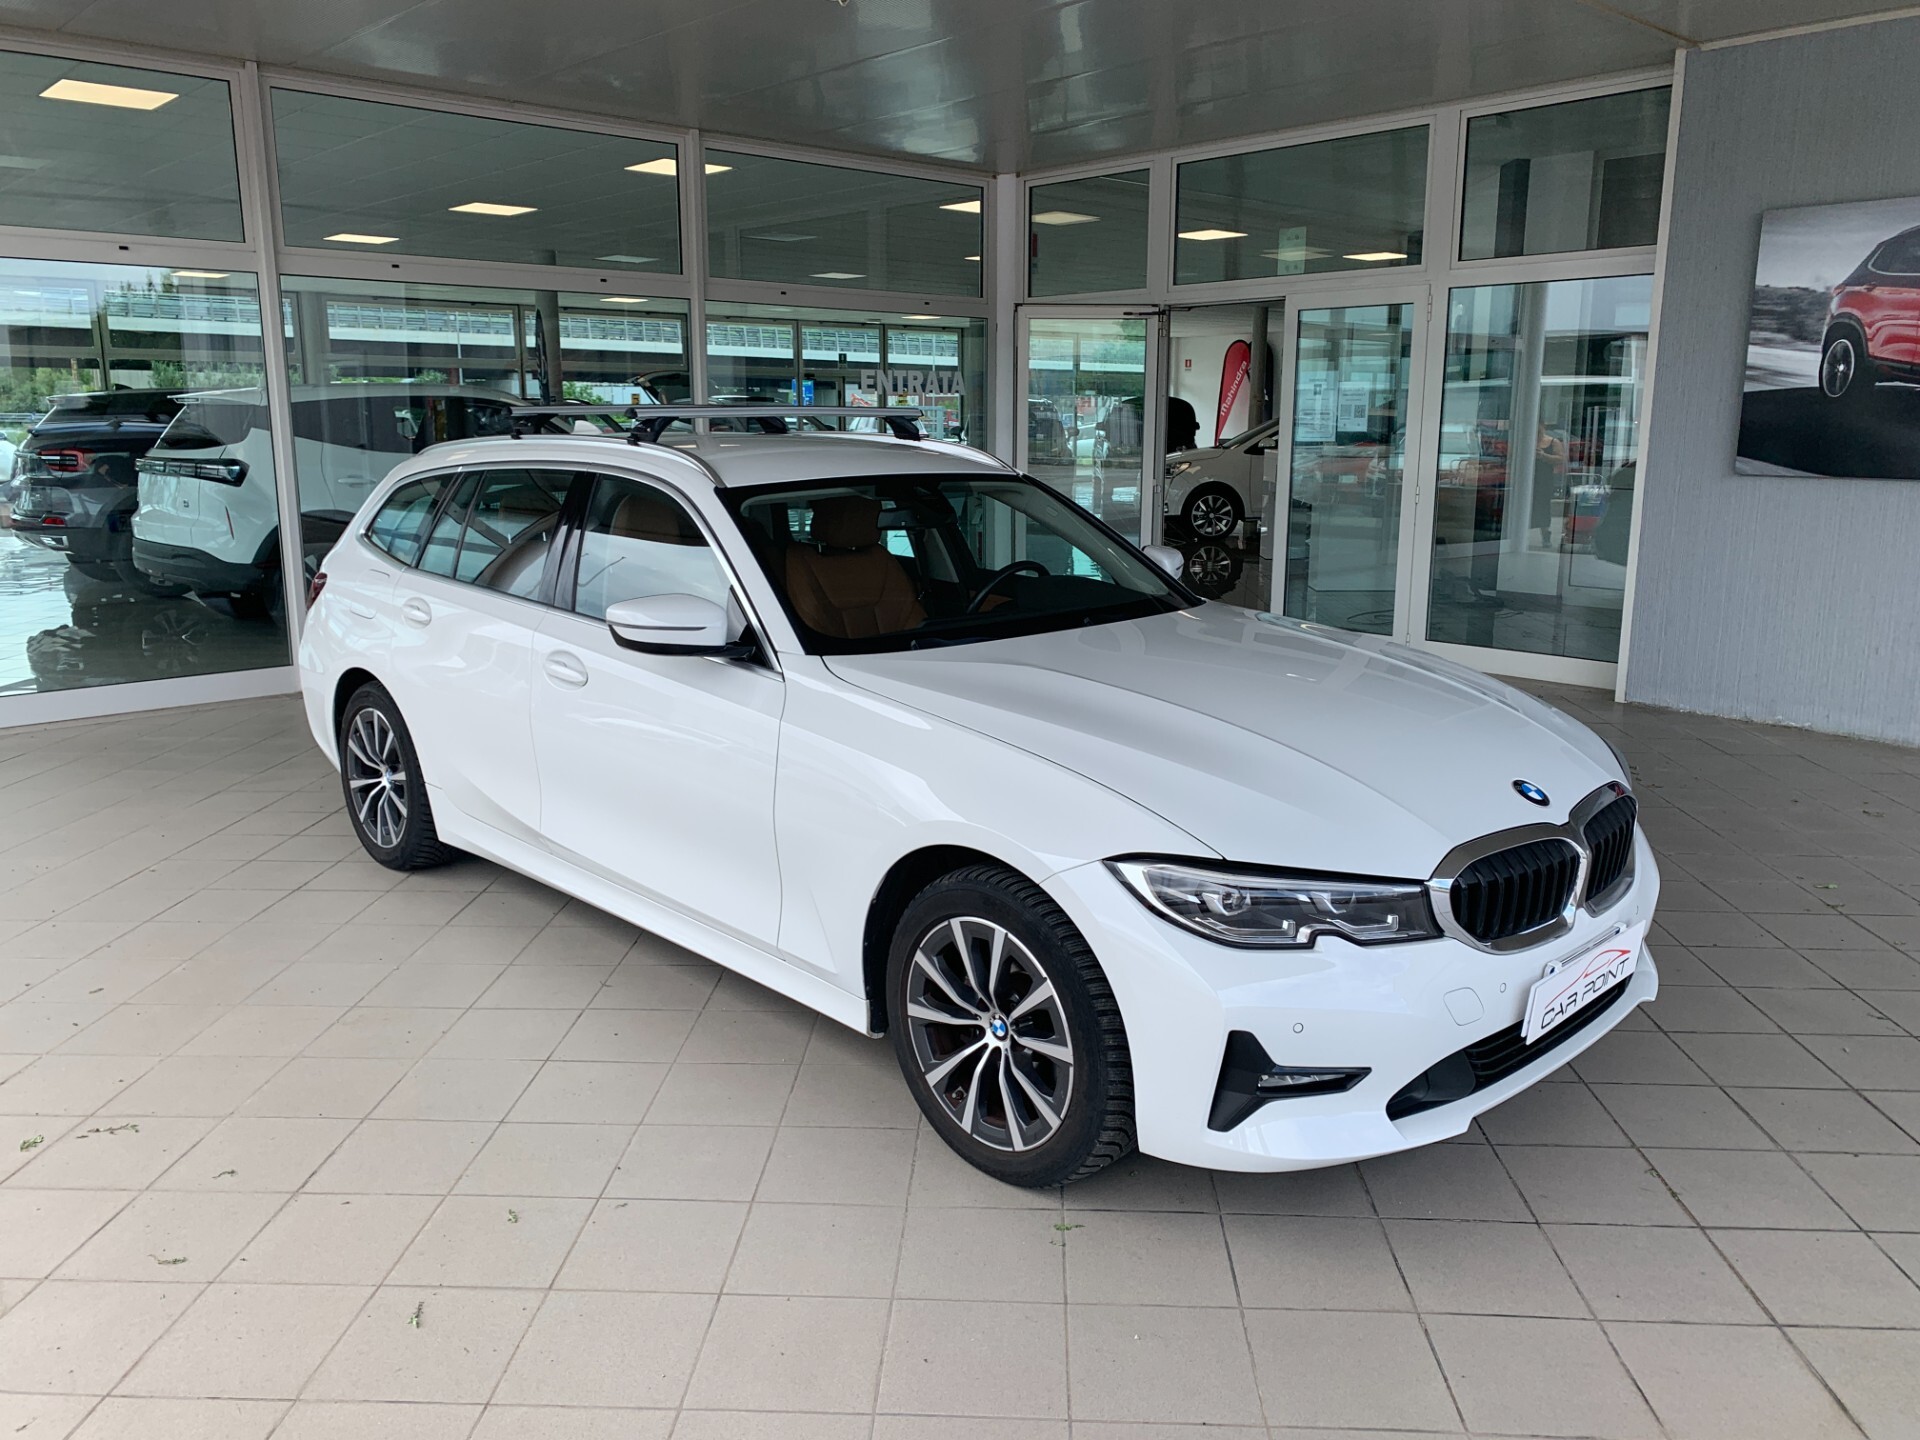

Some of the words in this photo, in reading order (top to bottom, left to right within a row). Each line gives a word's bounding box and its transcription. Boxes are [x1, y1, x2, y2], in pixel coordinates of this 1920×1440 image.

[861, 369, 965, 395] ENTRATA
[1541, 991, 1577, 1029] CAR
[1581, 957, 1629, 1001] POINT
